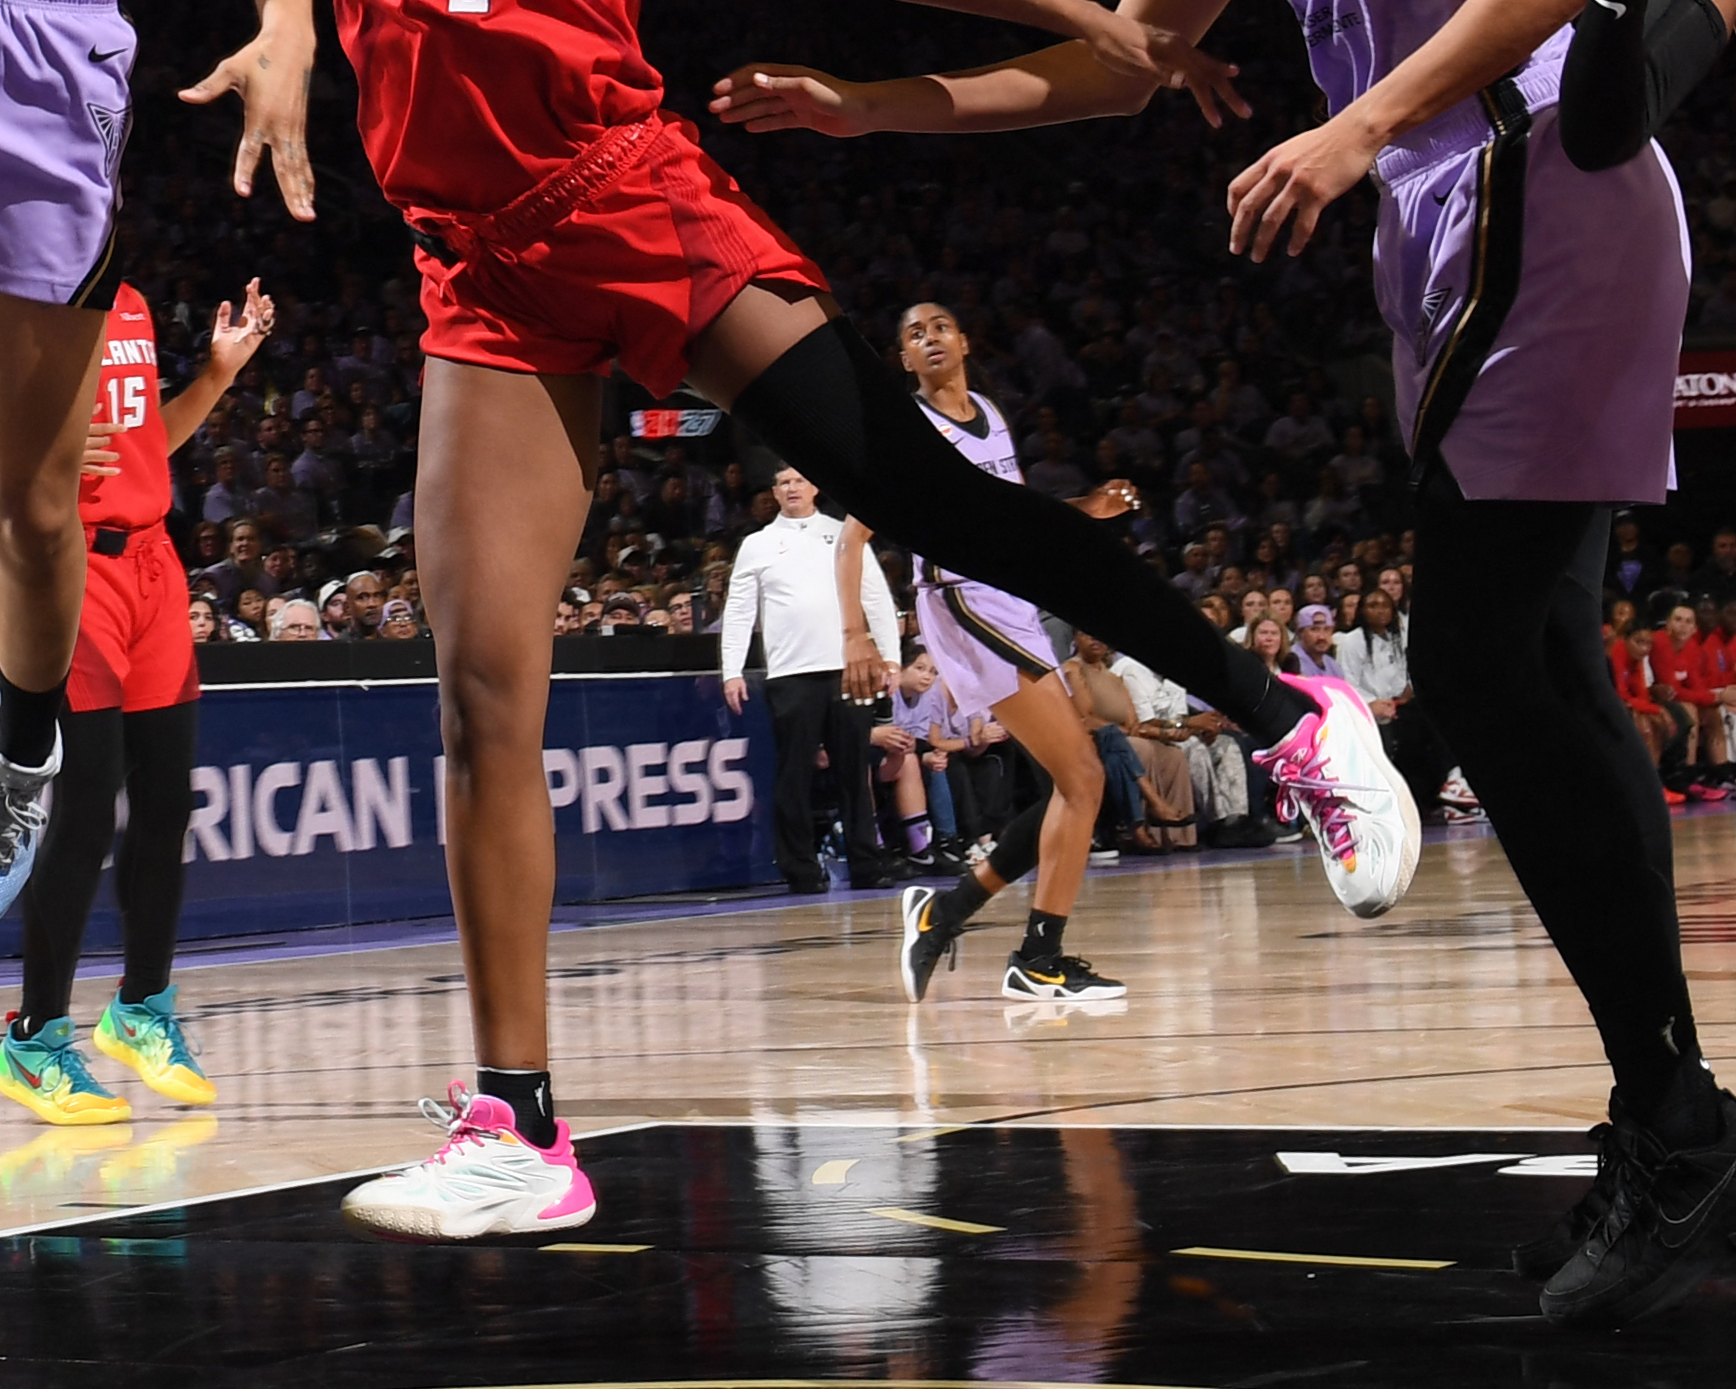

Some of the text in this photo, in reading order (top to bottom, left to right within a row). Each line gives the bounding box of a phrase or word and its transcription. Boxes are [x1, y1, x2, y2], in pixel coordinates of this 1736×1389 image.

[107, 375, 148, 428] 15
[182, 737, 755, 865] RICAN PRESS
